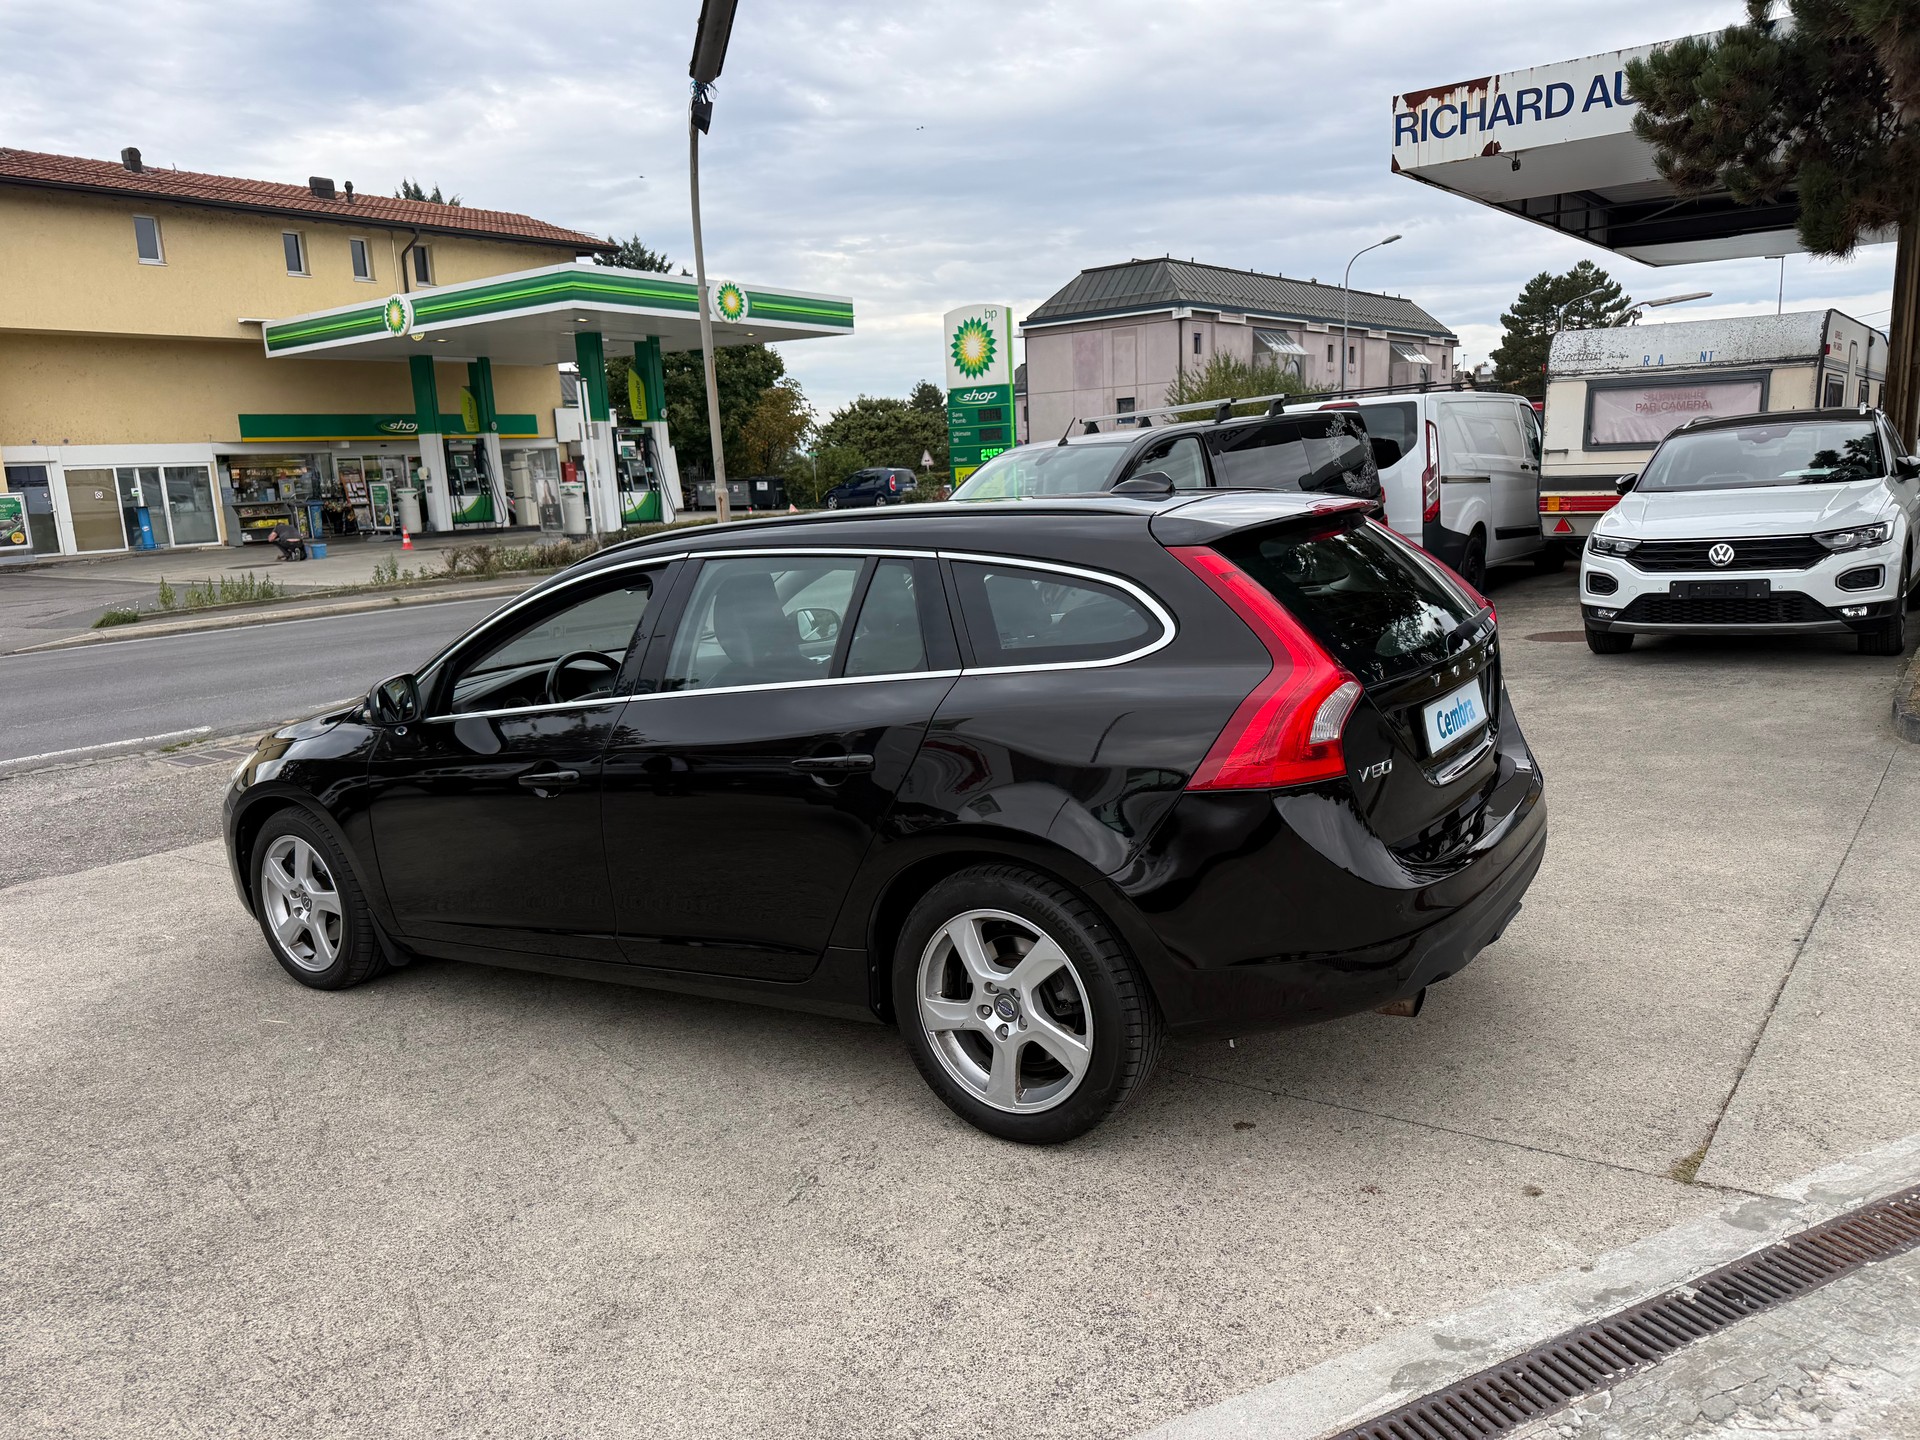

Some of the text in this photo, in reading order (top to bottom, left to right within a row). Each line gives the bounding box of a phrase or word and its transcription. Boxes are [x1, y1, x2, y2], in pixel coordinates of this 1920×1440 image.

[1395, 82, 1575, 147] RICHARD
[984, 308, 998, 321] bp
[962, 389, 998, 404] shop
[1430, 643, 1495, 687] VOLVO
[1436, 697, 1476, 739] Cembra
[1358, 758, 1393, 783] V60
